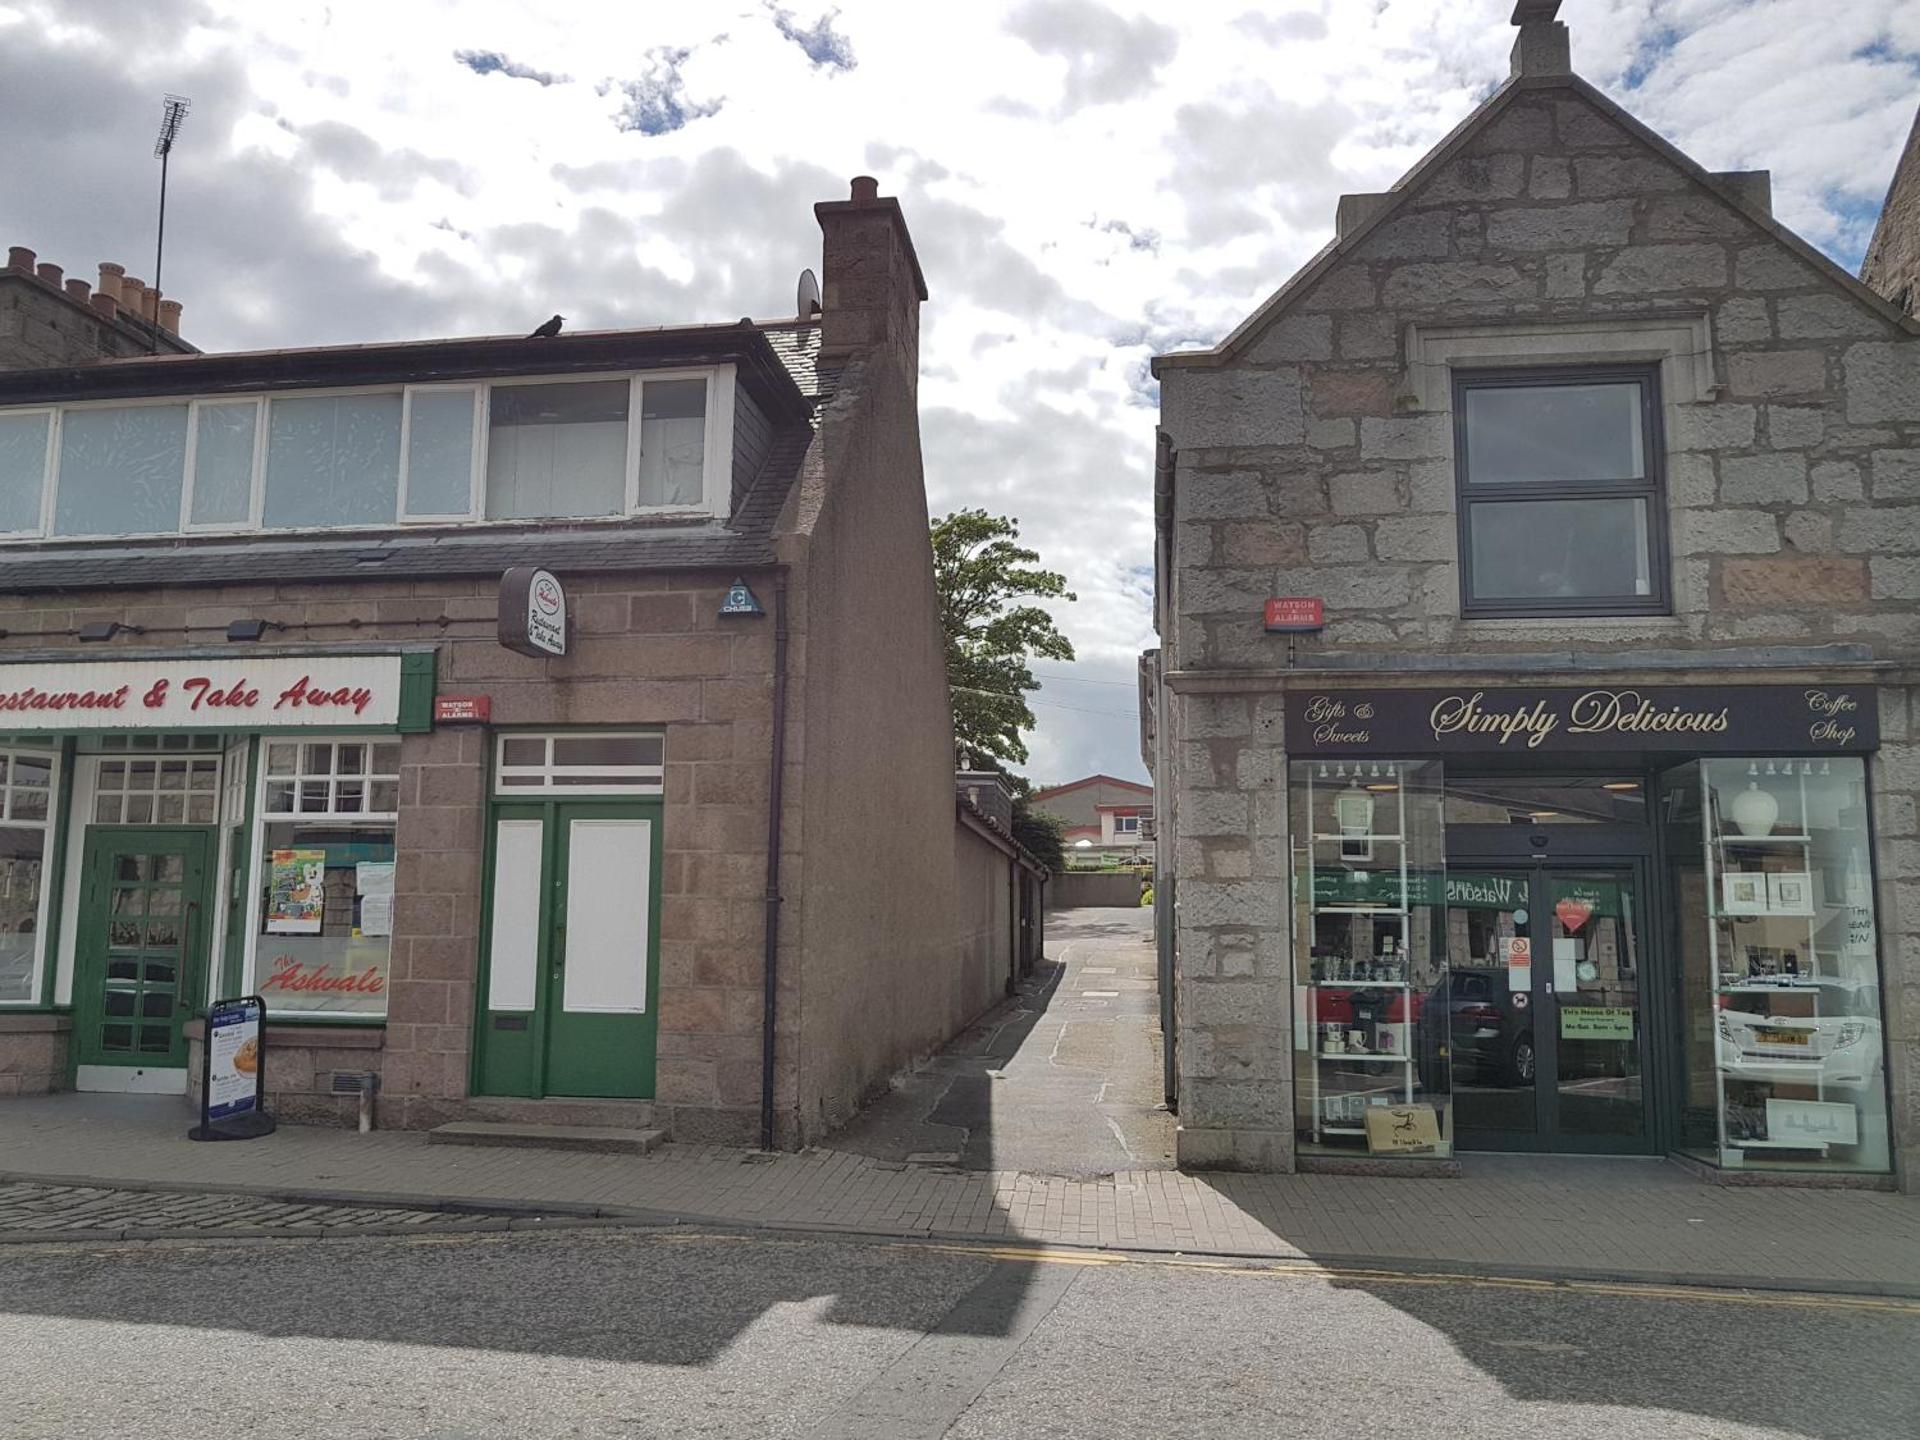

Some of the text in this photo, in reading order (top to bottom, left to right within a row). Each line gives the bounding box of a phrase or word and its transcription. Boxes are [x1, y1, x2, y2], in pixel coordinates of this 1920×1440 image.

[1272, 600, 1315, 609] WATSON
[1274, 613, 1315, 621] ALARMS
[0, 675, 371, 715] estaurant & Take Away
[1804, 690, 1857, 717] Coffee
[1304, 695, 1375, 724] Gifts &
[1430, 690, 1729, 748] Simply Delicious
[1312, 722, 1370, 746] Sweets
[1809, 720, 1855, 745] Shop
[260, 963, 384, 993] Ashvale
